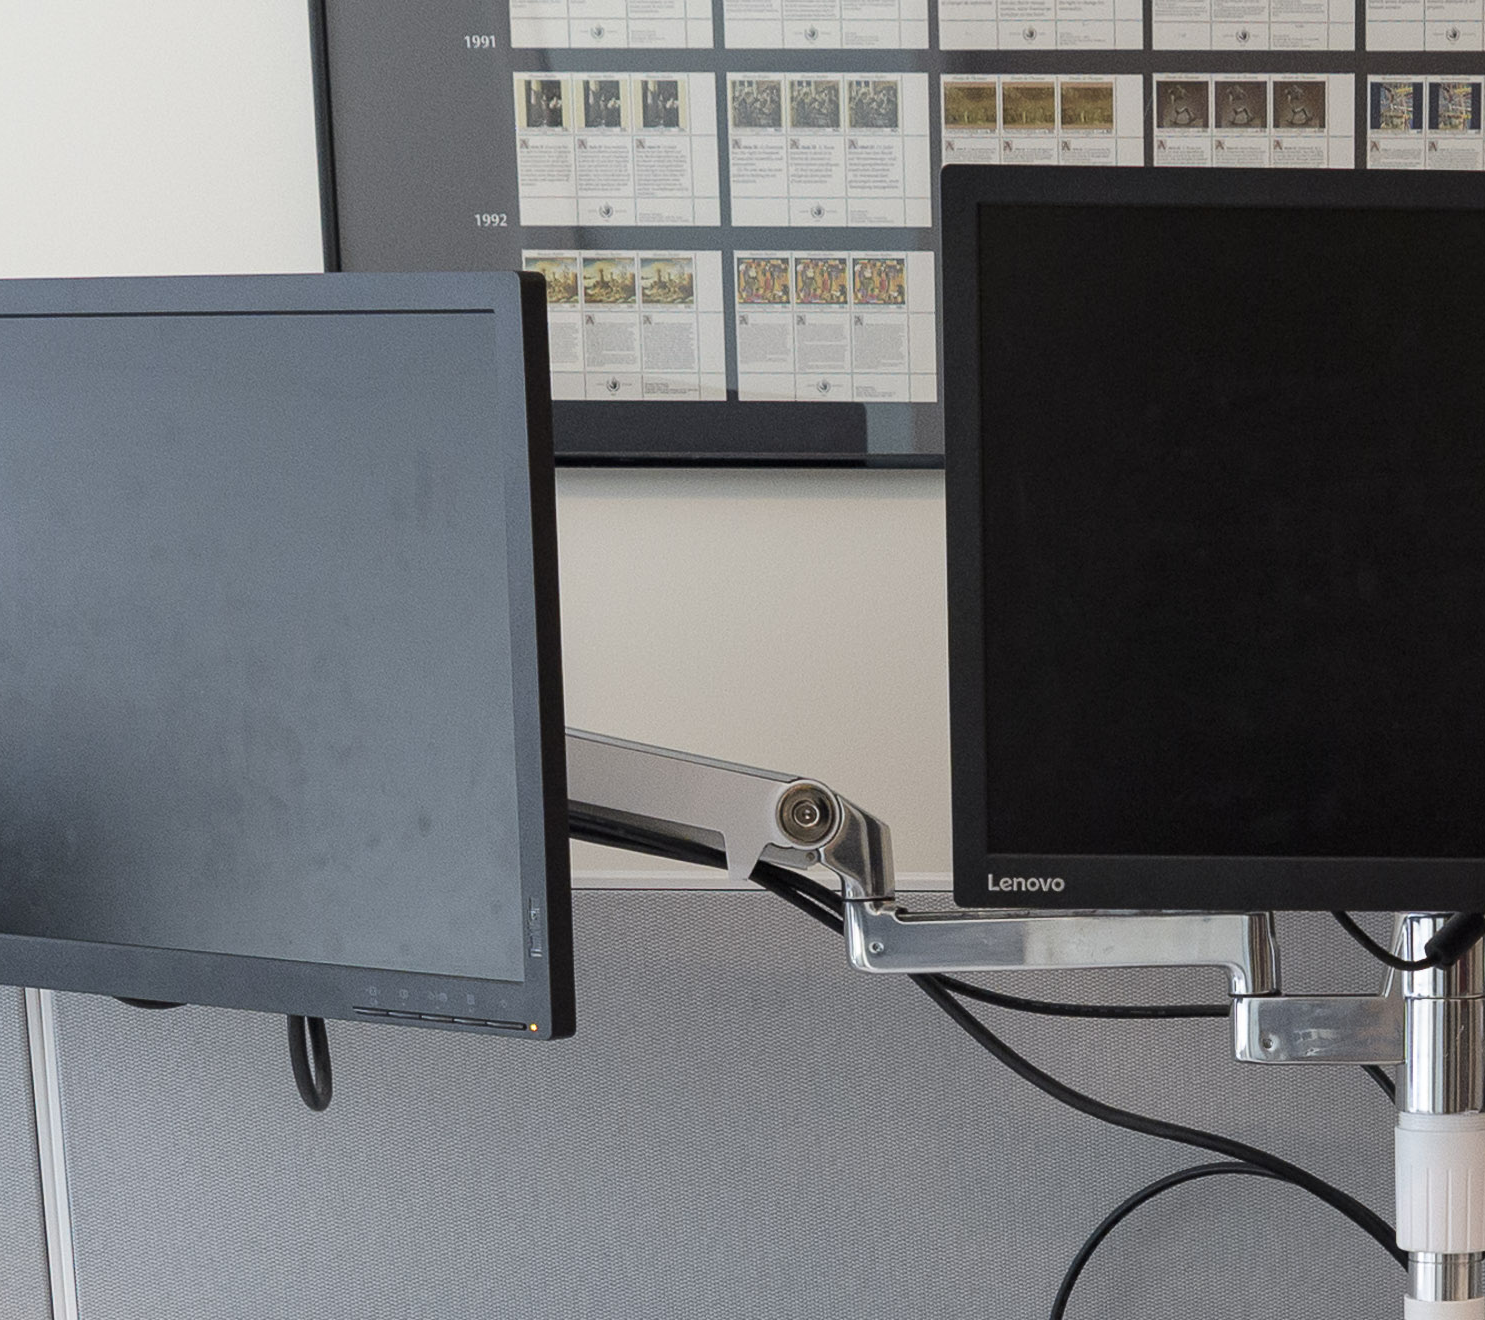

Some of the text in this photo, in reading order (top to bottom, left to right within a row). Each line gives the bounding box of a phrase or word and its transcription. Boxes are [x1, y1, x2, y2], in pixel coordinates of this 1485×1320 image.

[465, 35, 496, 49] 1991
[474, 213, 507, 227] 1992
[988, 874, 1065, 892] Lenovo
